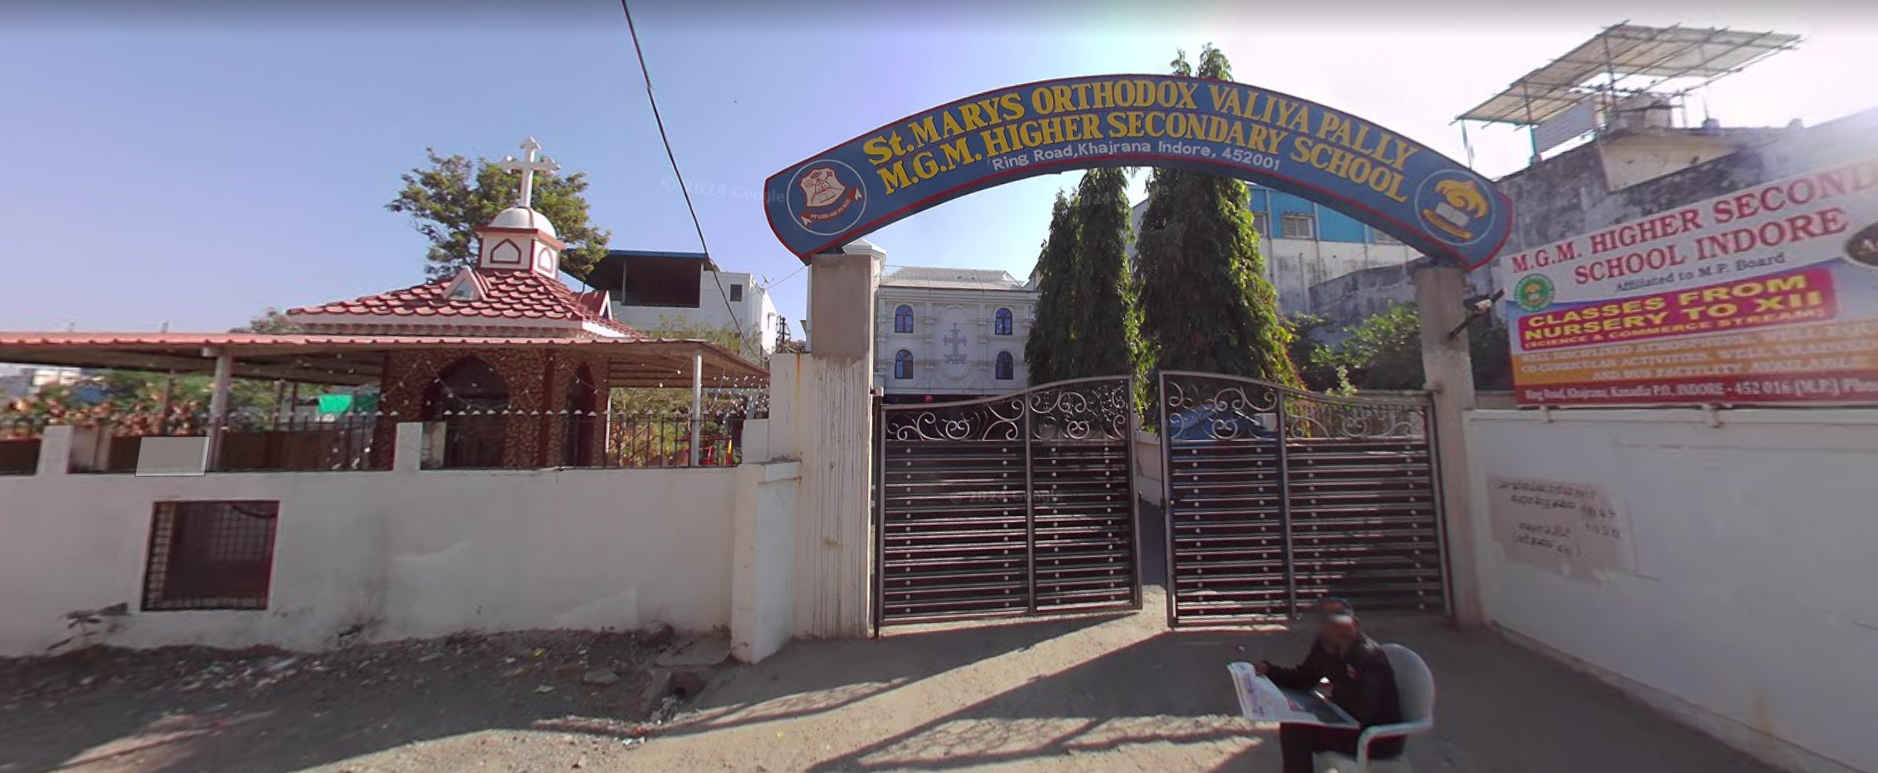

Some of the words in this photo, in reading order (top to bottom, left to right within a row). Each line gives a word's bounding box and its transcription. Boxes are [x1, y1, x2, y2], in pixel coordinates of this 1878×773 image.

[1032, 79, 1199, 115] ORTHODOX
[1208, 84, 1310, 133] VALIYA
[1316, 111, 1419, 171] PALLY
[876, 136, 983, 195] M.G.M.
[980, 113, 1104, 157] HIGHER
[1106, 111, 1290, 155] SECONDARY
[1290, 136, 1409, 203] SCHOOL
[991, 153, 1030, 171] Ring
[1158, 140, 1217, 159] Indore,
[1221, 149, 1281, 171] 452001
[1511, 241, 1582, 273] M.G.M.
[1590, 208, 1704, 254] HIGHER
[1574, 245, 1688, 285] SCHOOL
[1694, 207, 1849, 260] INDORE
[1679, 271, 1695, 281] to
[1735, 251, 1787, 271] Board
[1524, 311, 1670, 340] NURSERY
[1680, 302, 1738, 321] TO
[1754, 291, 1823, 312] XII
[1528, 297, 1666, 327] CLASSES
[1678, 275, 1807, 306] FROM
[1592, 333, 1604, 341] &
[1608, 321, 1712, 339] COMMERCE
[1735, 381, 1761, 394] 452
[1763, 380, 1791, 393] 016
